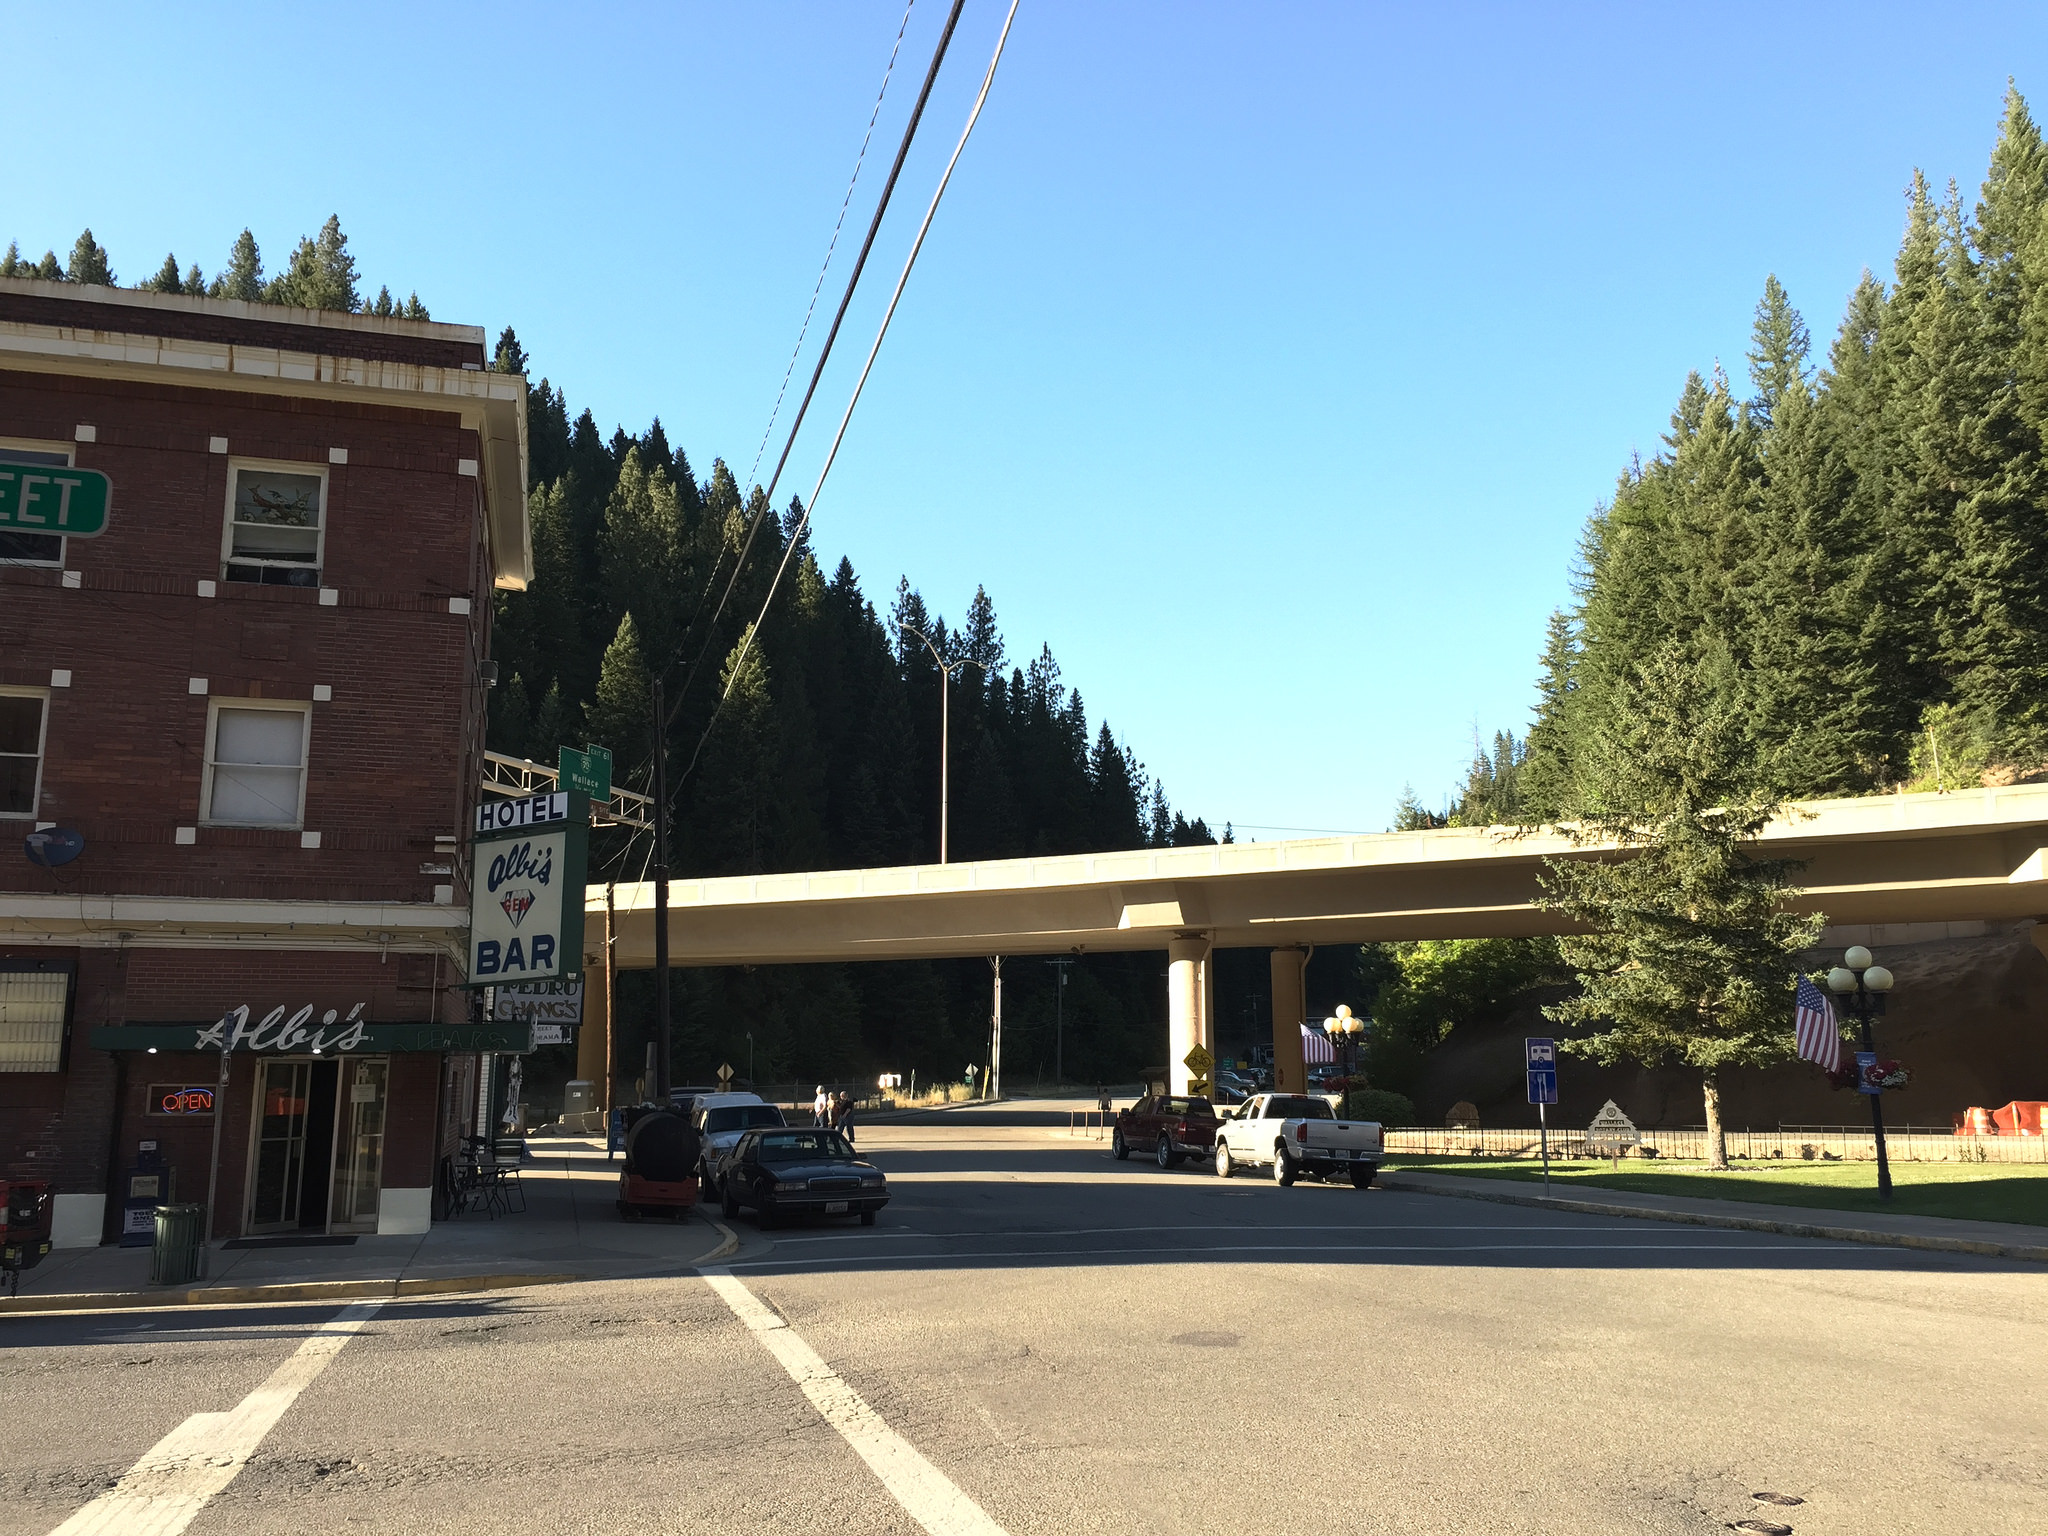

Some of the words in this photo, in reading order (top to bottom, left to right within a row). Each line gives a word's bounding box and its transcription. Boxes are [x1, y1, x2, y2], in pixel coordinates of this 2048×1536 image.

[590, 748, 601, 757] EXIT
[572, 773, 599, 788] Wallace
[480, 795, 563, 829] HOTEL
[476, 934, 556, 975] BAR
[194, 1002, 370, 1050] Albi's
[163, 1094, 211, 1110] OPEN
